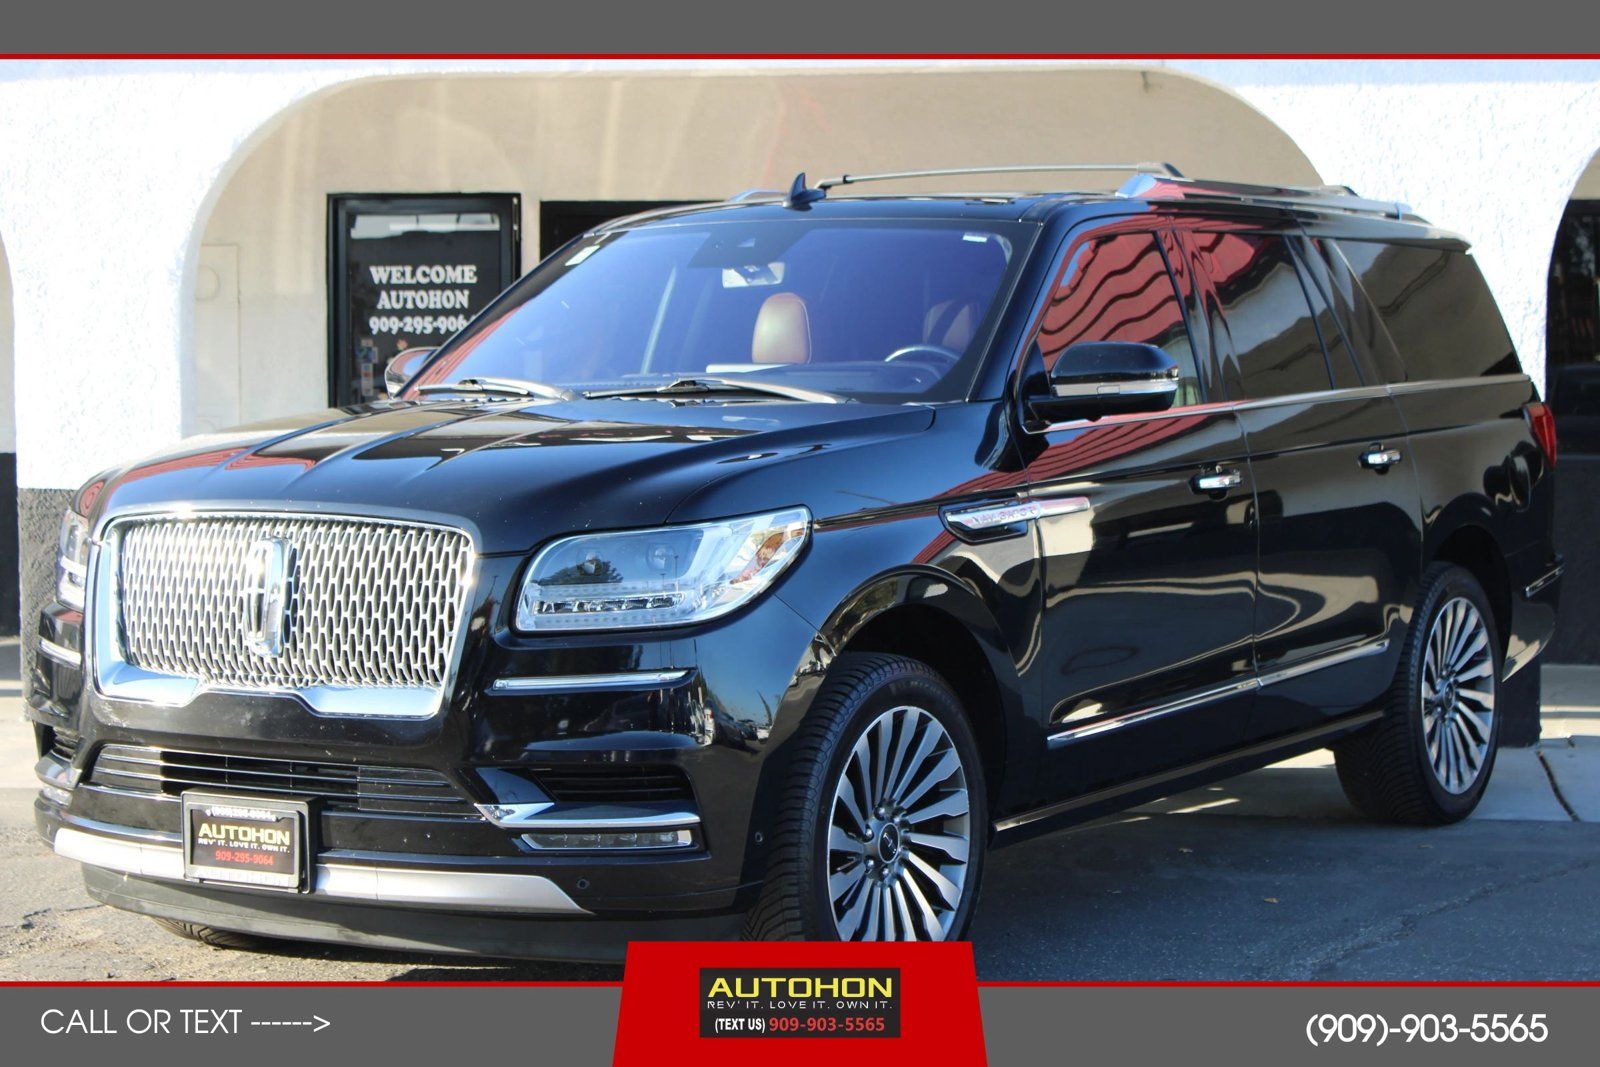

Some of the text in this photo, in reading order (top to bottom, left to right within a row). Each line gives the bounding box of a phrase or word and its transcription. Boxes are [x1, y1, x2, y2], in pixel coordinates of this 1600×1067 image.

[369, 265, 478, 284] WELCOME
[376, 290, 470, 309] AUTOHON
[369, 314, 475, 335] 909-295-906
[198, 823, 290, 846] AUTOHON
[229, 840, 249, 849] LOVE
[262, 844, 279, 852] OWN
[215, 850, 274, 866] 909-295-9064
